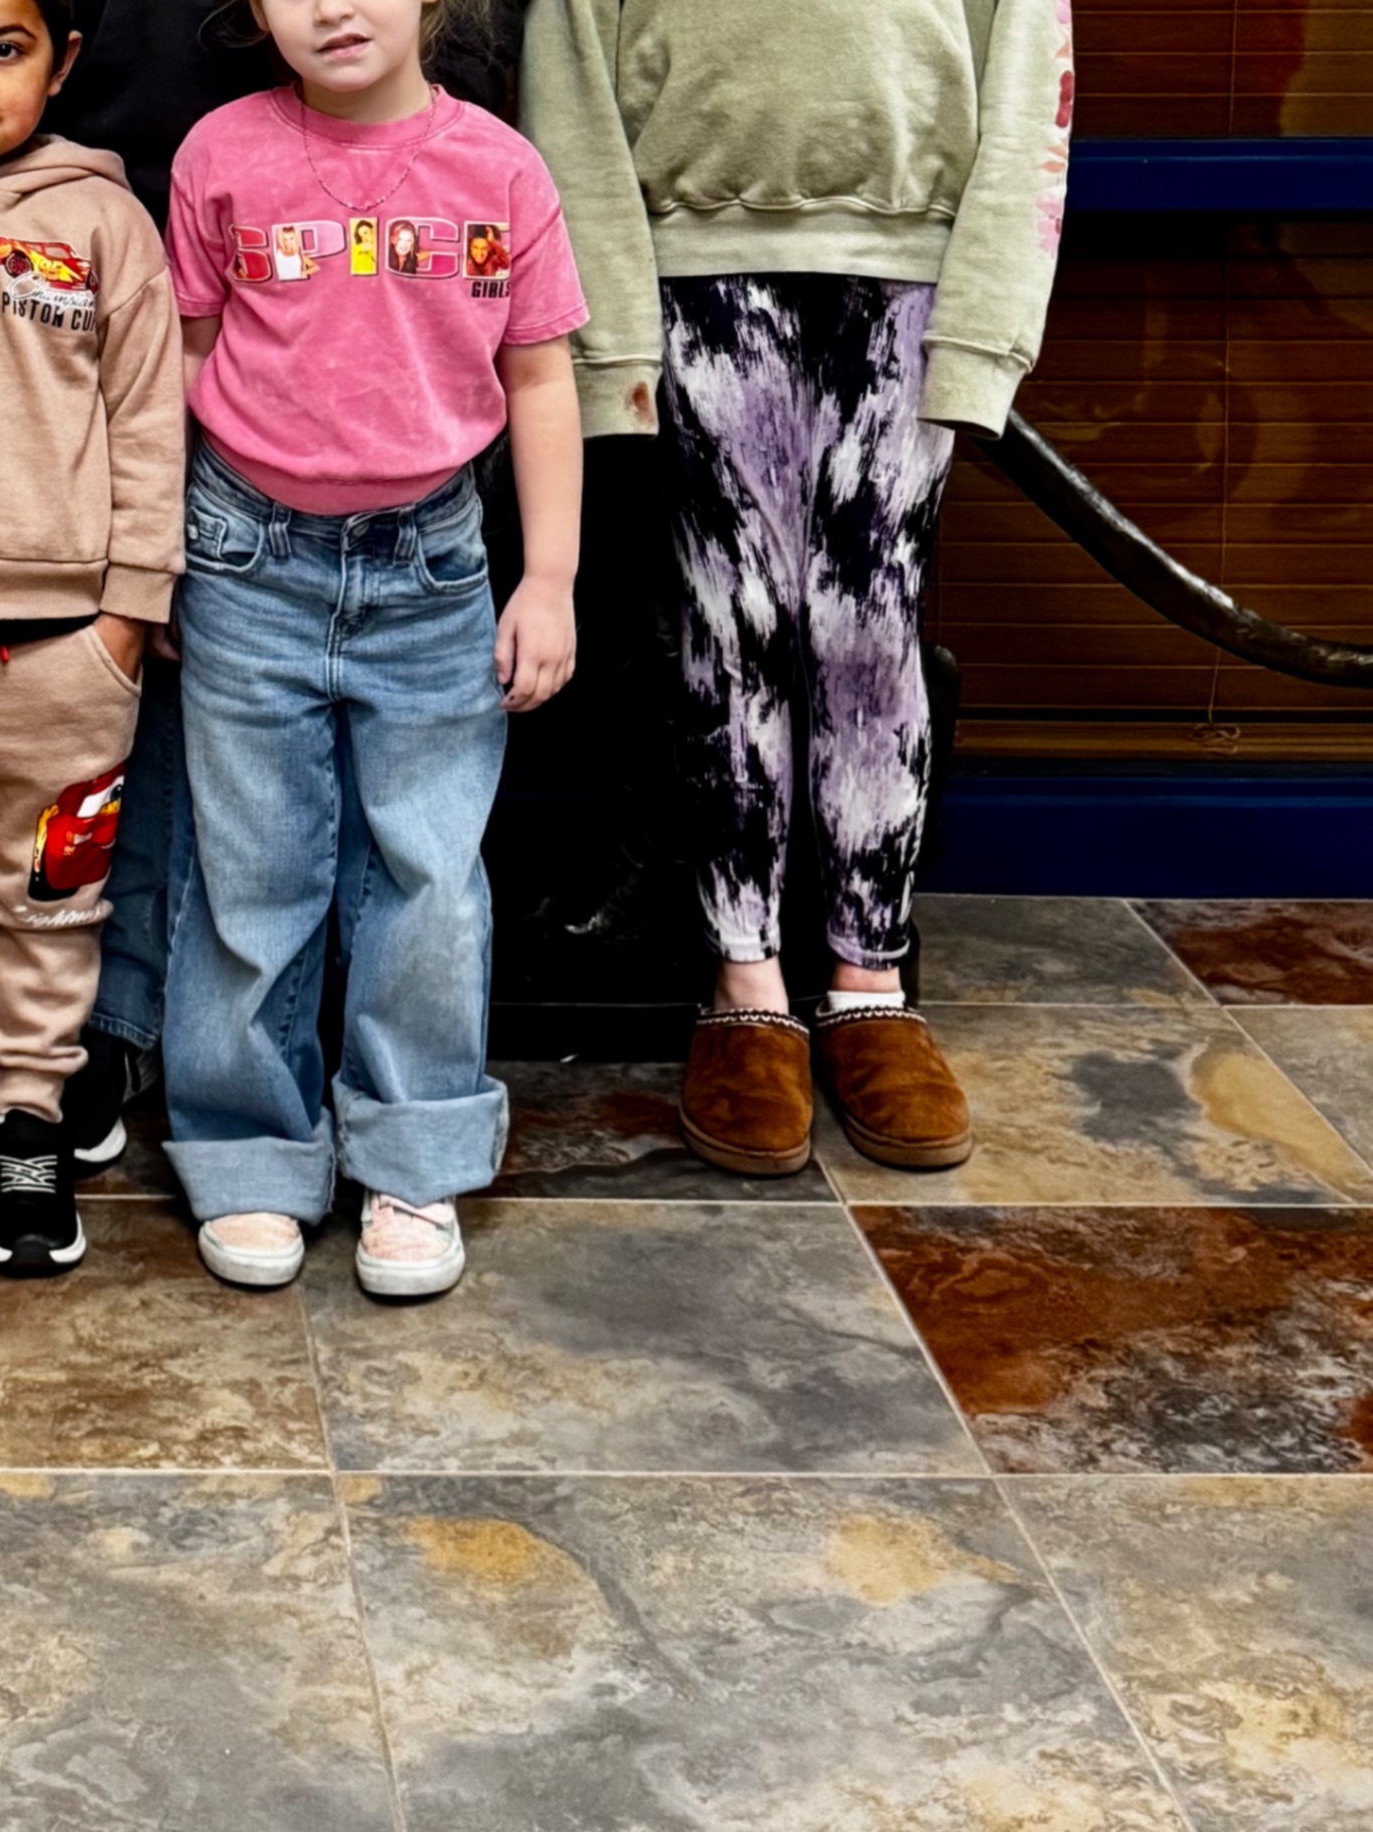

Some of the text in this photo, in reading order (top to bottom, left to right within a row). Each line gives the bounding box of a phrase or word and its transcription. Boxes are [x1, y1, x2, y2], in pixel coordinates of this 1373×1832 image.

[228, 216, 510, 282] SPICE
[471, 281, 511, 299] GIRLS
[2, 291, 65, 328] PISTON
